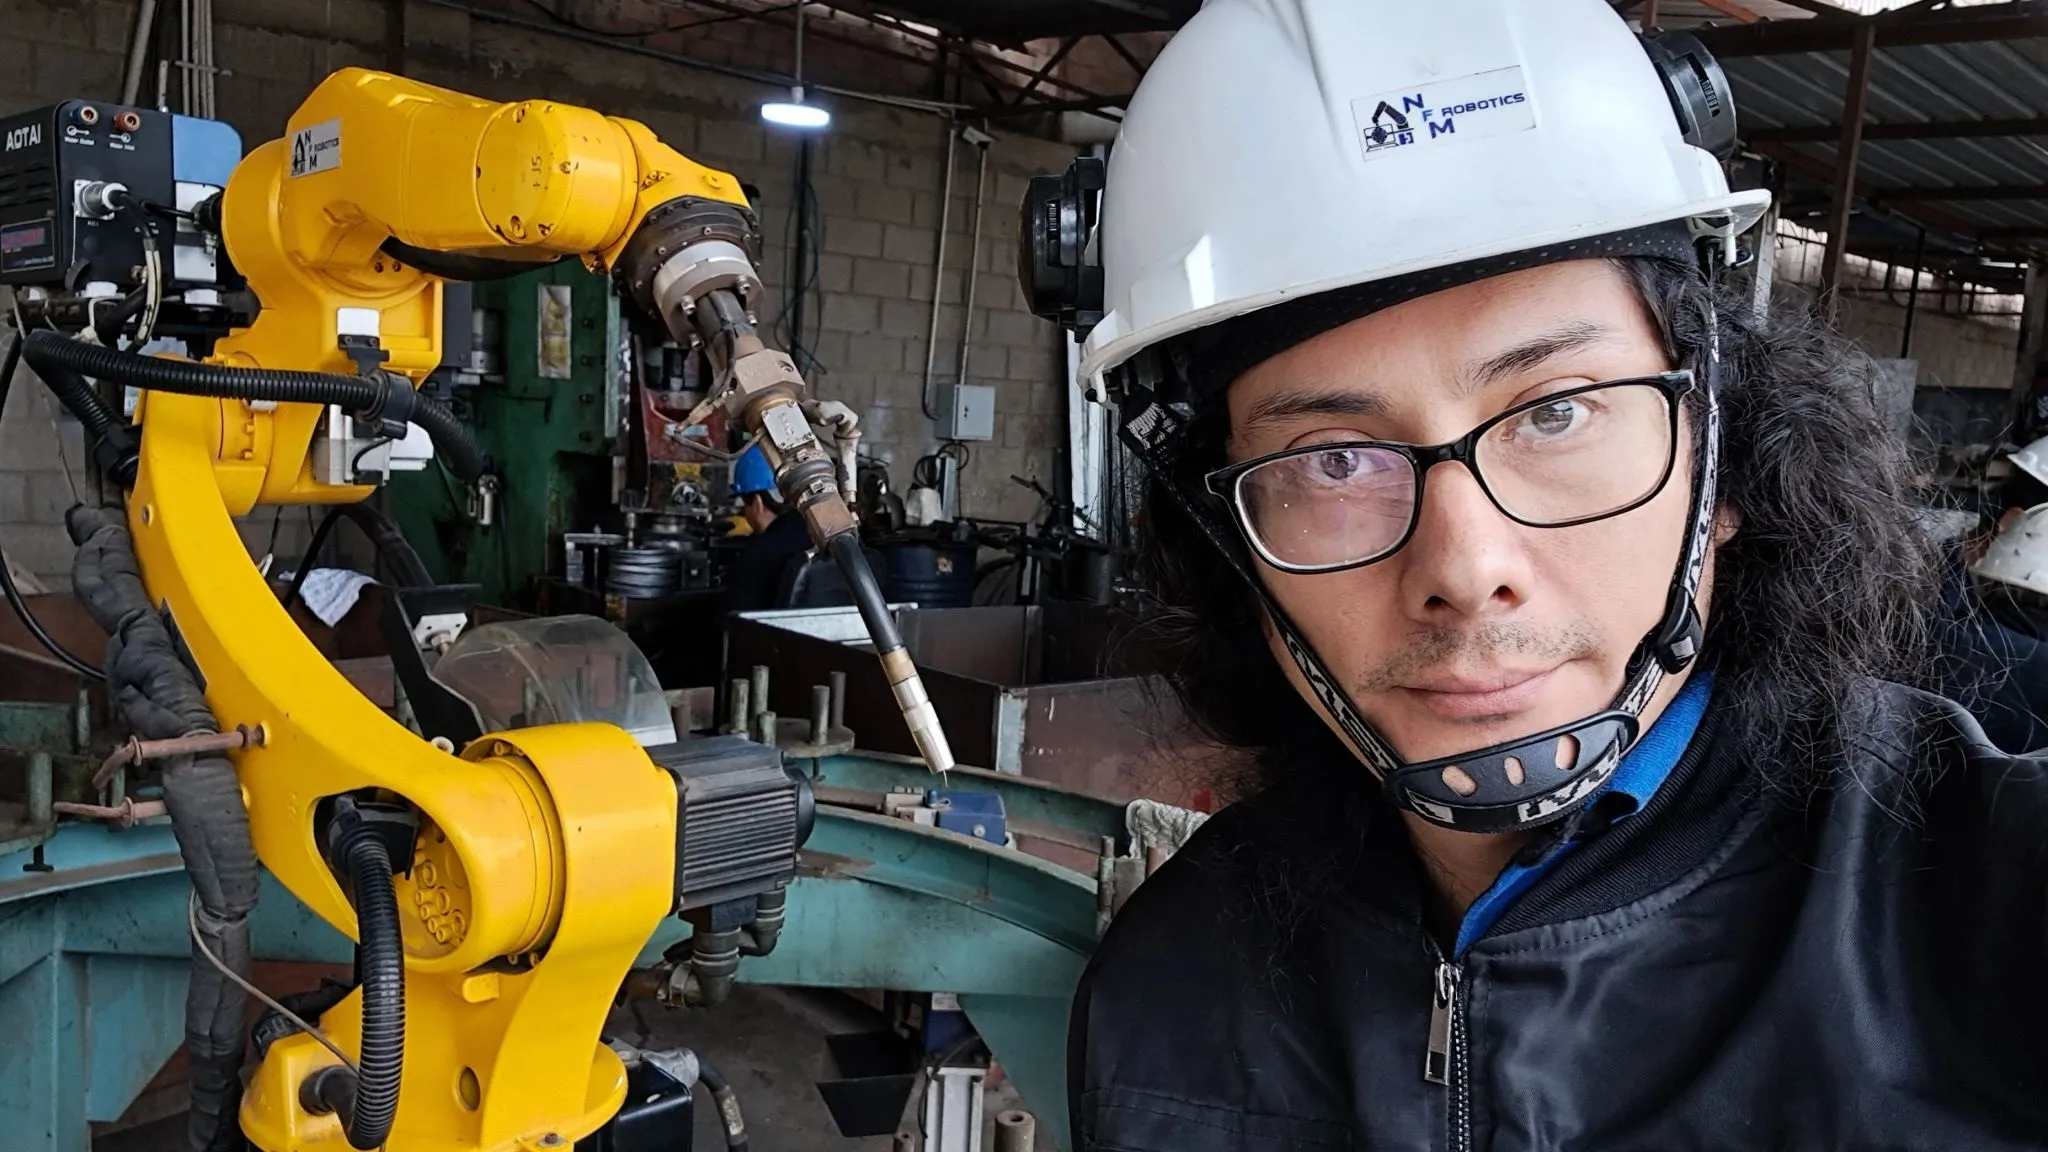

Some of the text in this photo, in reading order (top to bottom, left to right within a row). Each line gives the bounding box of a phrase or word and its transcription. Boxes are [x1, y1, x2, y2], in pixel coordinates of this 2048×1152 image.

[1402, 93, 1425, 115] N
[1421, 92, 1526, 122] F ROBOTICS
[5, 123, 41, 152] AOTAI
[1429, 118, 1455, 140] M
